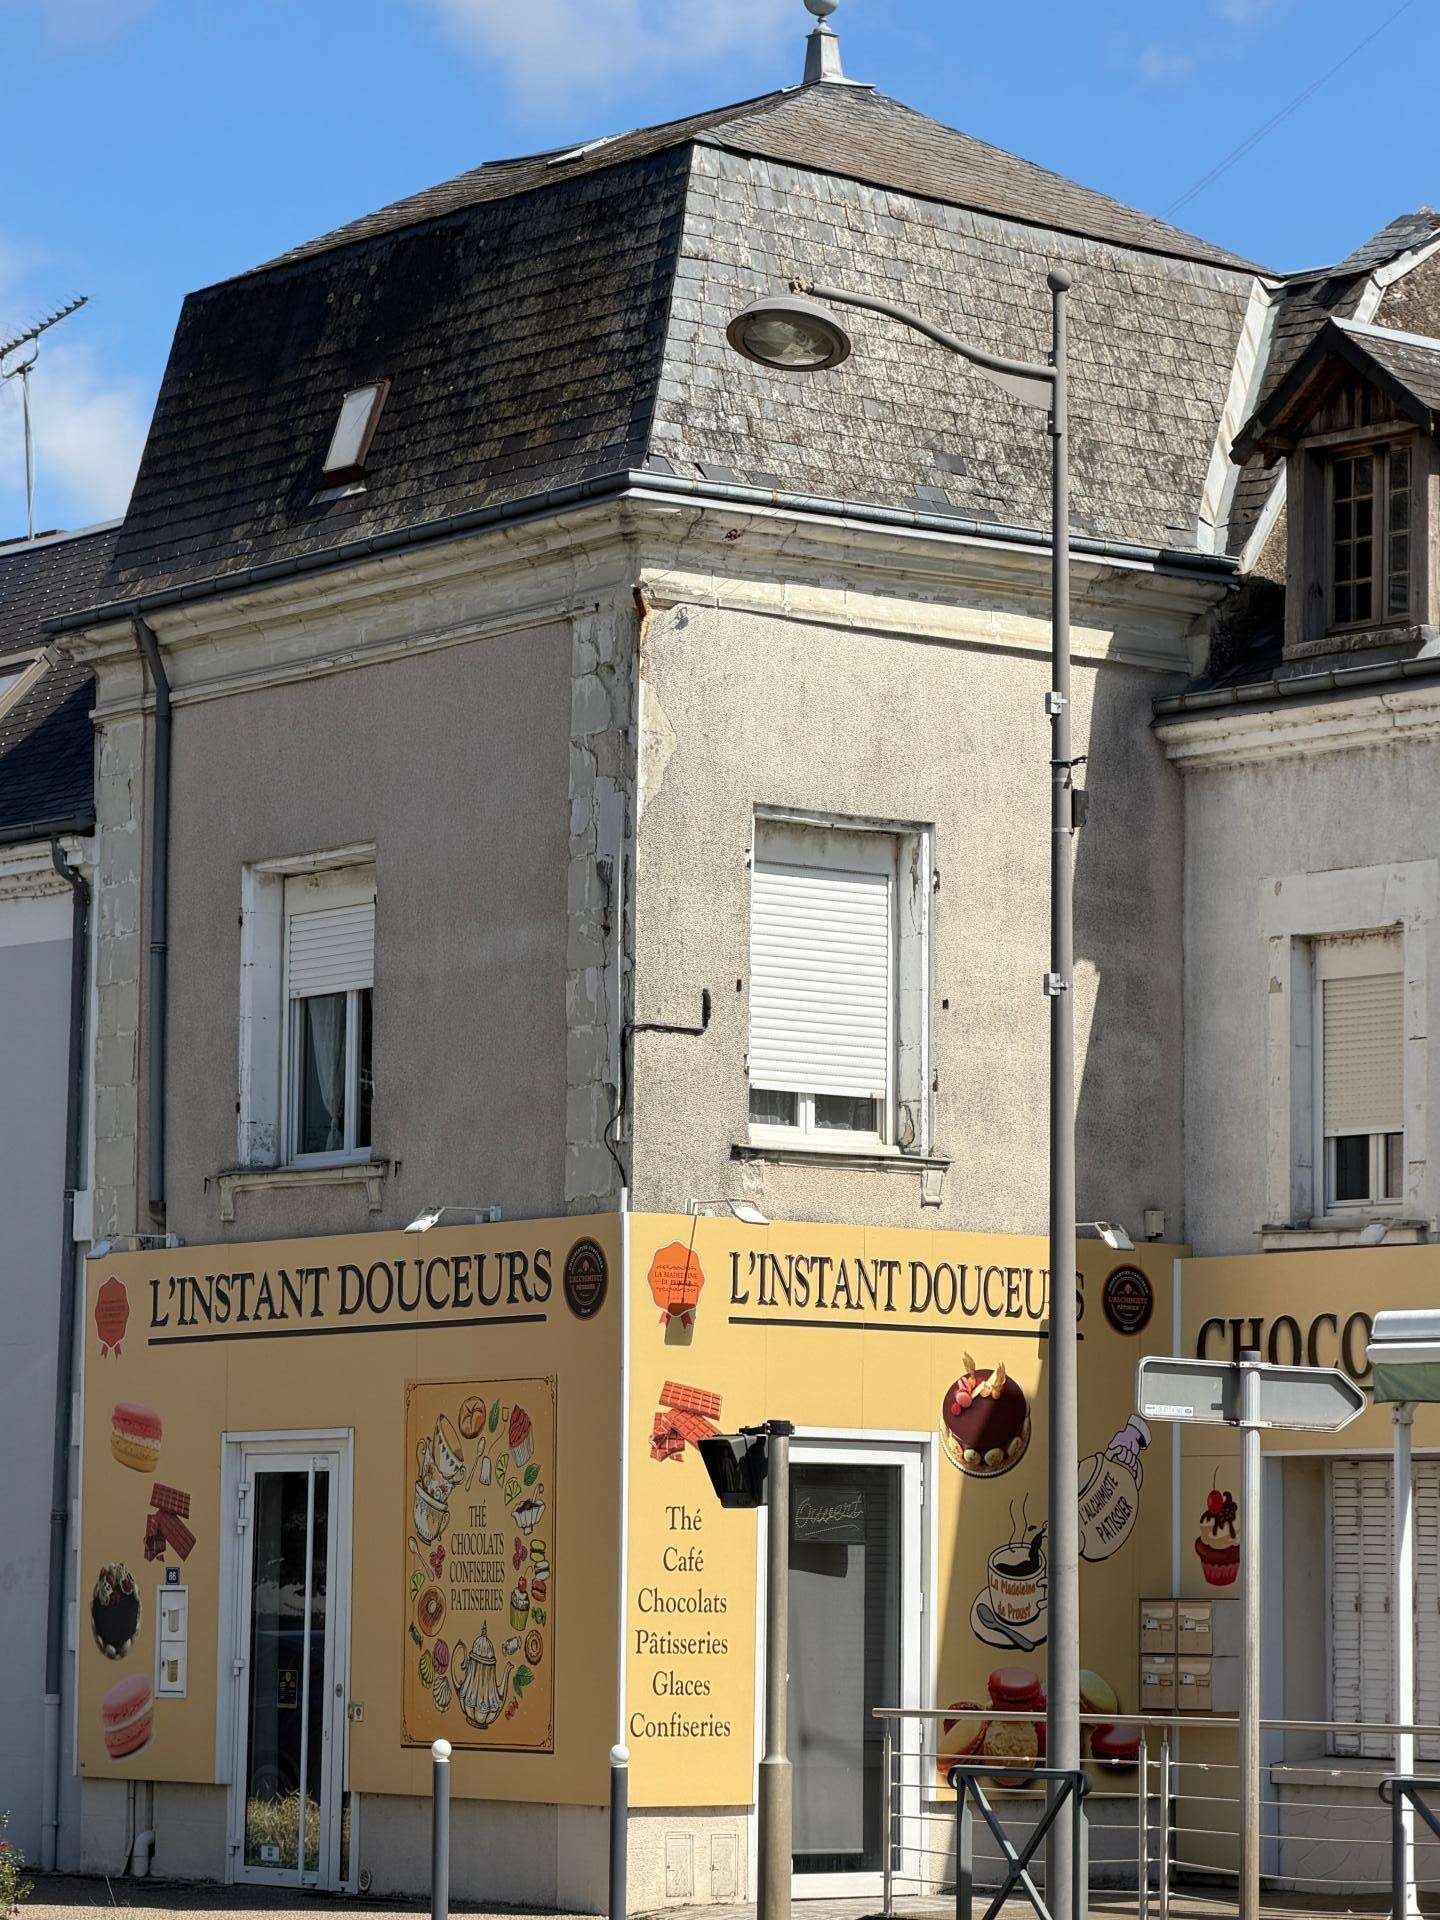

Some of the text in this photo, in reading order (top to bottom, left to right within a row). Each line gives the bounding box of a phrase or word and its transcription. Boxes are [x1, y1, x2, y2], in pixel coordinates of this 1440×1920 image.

[149, 1266, 330, 1328] L'INSTANT
[337, 1248, 552, 1316] DOUCEURS
[728, 1250, 1084, 1322] L'INSTANT DOUCEUS
[469, 1498, 487, 1528] THÉ
[665, 1505, 702, 1531] Thé
[450, 1532, 505, 1556] CHOCOLATS
[449, 1560, 506, 1584] CONFISERIES
[663, 1546, 704, 1572] Café
[991, 1574, 998, 1591] La
[450, 1588, 504, 1611] PATISSERIES
[637, 1587, 727, 1613] Chocolats
[1007, 1602, 1031, 1620] Proust
[635, 1629, 729, 1655] Pâtisseries
[652, 1670, 711, 1696] Glaces
[630, 1711, 731, 1738] Confiseries
